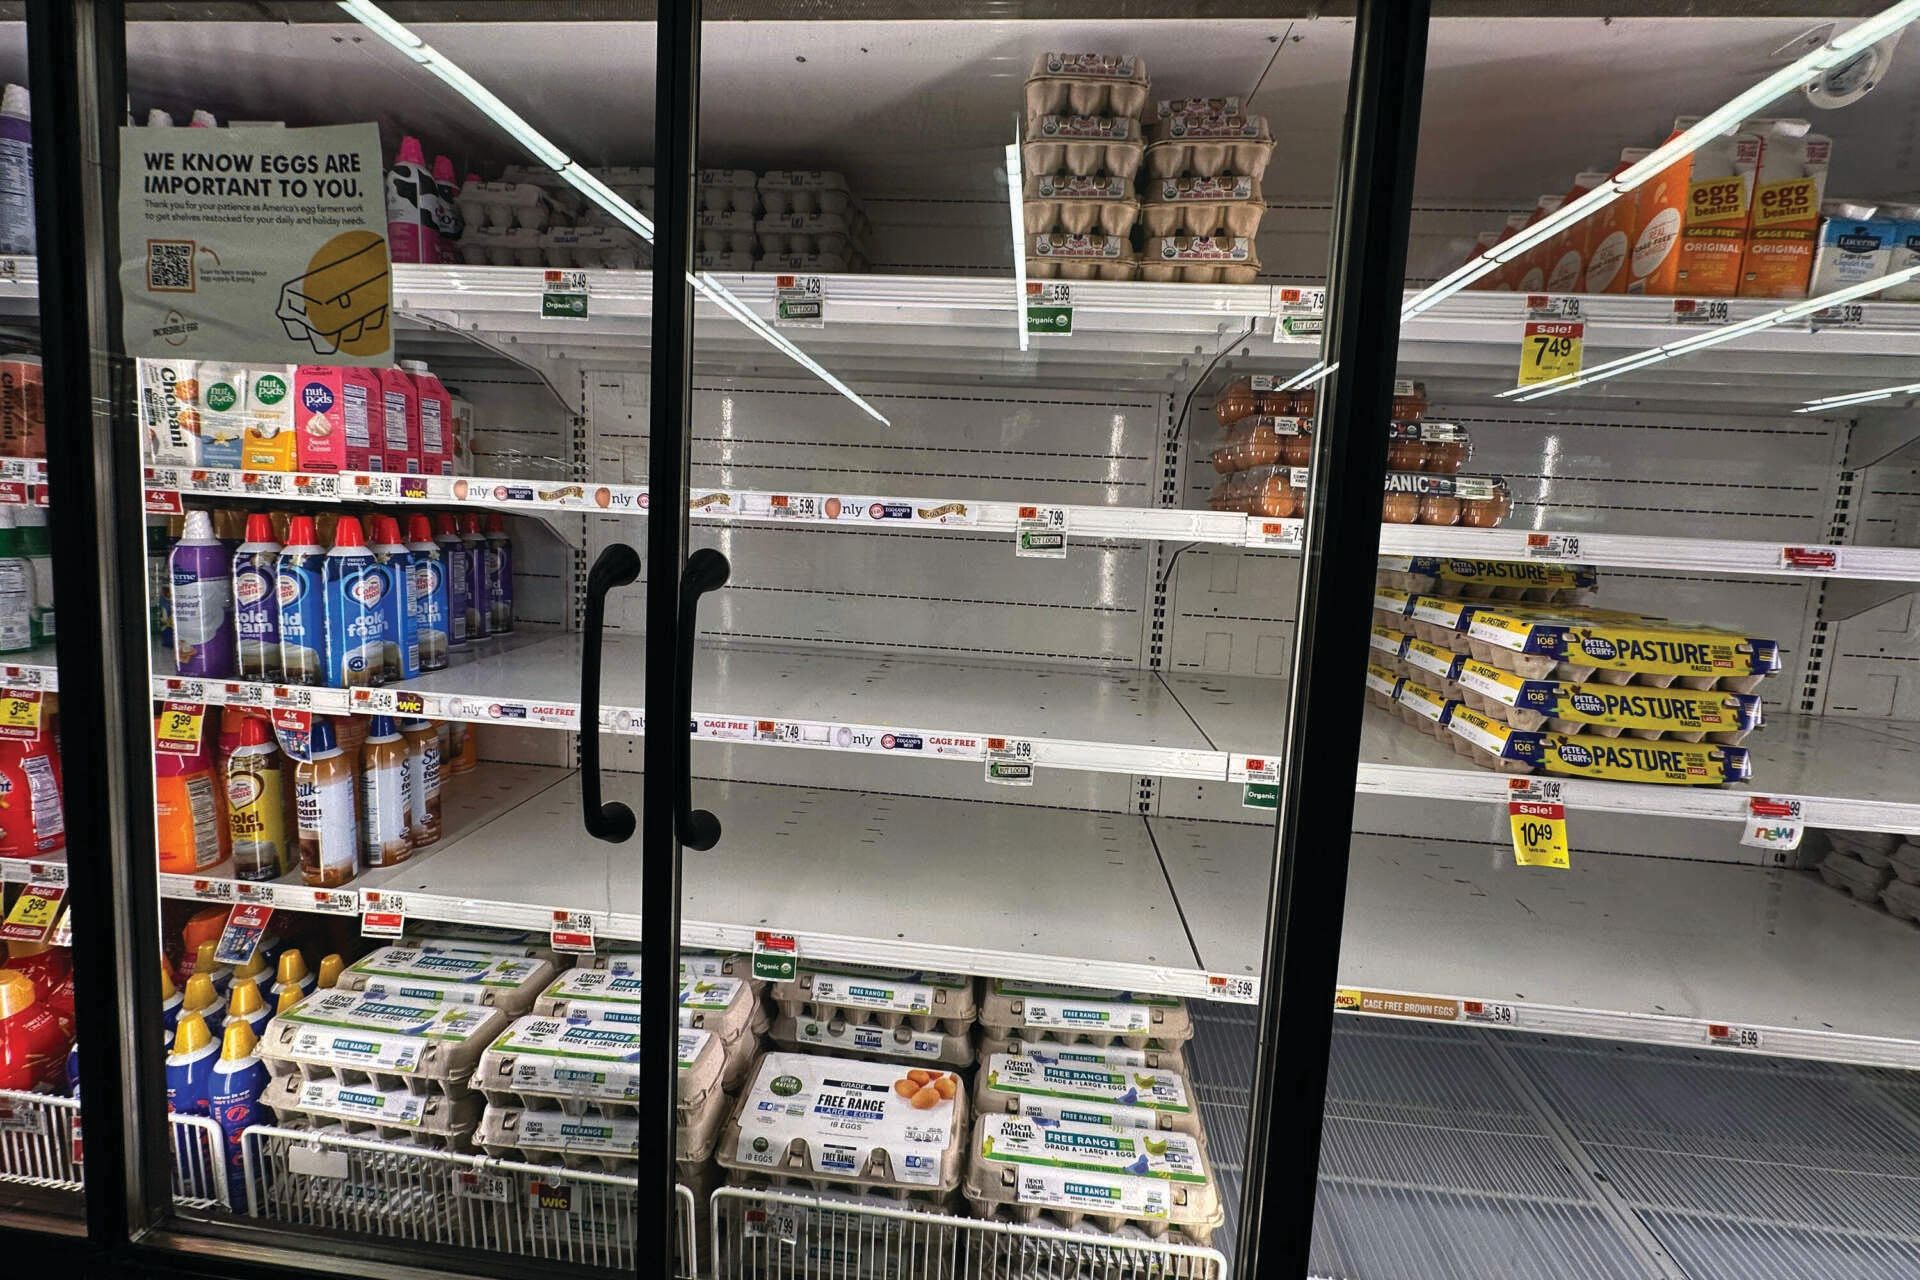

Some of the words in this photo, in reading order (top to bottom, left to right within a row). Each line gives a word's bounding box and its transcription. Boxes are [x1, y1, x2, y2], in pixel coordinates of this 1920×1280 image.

[144, 153, 175, 171] WE
[182, 154, 253, 174] KNOW
[260, 155, 318, 174] EGGS
[325, 153, 361, 173] ARE
[144, 176, 272, 197] IMPORTANT
[279, 178, 308, 198] TO
[314, 179, 364, 199] YOU.
[1693, 182, 1740, 206] egg
[1761, 183, 1810, 208] egg
[145, 200, 168, 210] Thank
[169, 202, 185, 212] you
[186, 200, 197, 211] for
[198, 203, 215, 213] your
[217, 201, 252, 213] patience
[252, 204, 261, 212] as
[262, 203, 300, 213] America's
[301, 205, 316, 216] egg
[317, 203, 345, 213] farmers
[346, 204, 364, 212] work
[1694, 204, 1739, 218] beaters
[1763, 204, 1808, 219] beaters
[145, 213, 154, 222] to
[155, 214, 170, 223] get
[172, 213, 200, 223] shelves
[202, 213, 242, 223] restocked
[243, 213, 255, 223] for
[256, 216, 275, 226] your
[276, 214, 295, 227] daily
[296, 214, 311, 225] and
[312, 215, 340, 227] holiday
[342, 216, 366, 226] needs.
[1839, 236, 1880, 247] Lucerne
[1684, 242, 1740, 254] ORIGINAL
[1752, 244, 1811, 256] ORIGINAL
[546, 302, 570, 310] Organic
[1026, 315, 1053, 325] Organic
[1536, 324, 1572, 334] Sale!
[259, 379, 277, 389] nut
[258, 386, 286, 398] pods
[305, 386, 324, 397] nut
[209, 392, 236, 405] pods
[304, 394, 333, 406] pods
[161, 367, 188, 449] Chobani
[1384, 475, 1430, 493] ANIC
[404, 490, 426, 499] WIC
[1478, 561, 1548, 580] PASTURE
[1536, 636, 1555, 646] 108
[1584, 639, 1603, 648] PETE
[1617, 638, 1713, 666] PASTURE
[1691, 664, 1713, 673] RAISED
[10, 690, 35, 699] Sale!
[1574, 695, 1593, 704] PETE
[171, 703, 196, 712] Sale!
[398, 699, 421, 711] WIC
[1605, 693, 1700, 721] PASTURE
[532, 707, 552, 716] CAGE
[553, 708, 576, 717] FREE
[703, 720, 726, 730] CAGE
[728, 721, 749, 730] FREE
[1680, 720, 1702, 728] RAISED
[929, 737, 952, 747] CAGE
[954, 738, 976, 748] FREE
[1561, 745, 1581, 754] PETE
[1592, 744, 1686, 773] PASTURE
[1665, 771, 1687, 780] RAISED
[1248, 791, 1276, 800] Organic
[1519, 803, 1553, 815] Sale!
[31, 888, 55, 896] Sale!
[443, 960, 475, 969] RANGE
[756, 962, 780, 973] Organic
[614, 980, 636, 989] FREE
[850, 988, 865, 996] FREE
[866, 989, 886, 999] RANGE
[360, 1003, 383, 1012] FREE
[386, 1006, 420, 1018] RANGE
[1363, 998, 1383, 1010] CAGE
[1384, 1000, 1402, 1011] FREE
[1404, 1001, 1433, 1014] BROWN
[1434, 1005, 1455, 1017] EGGS
[569, 1029, 595, 1040] FREE
[596, 1031, 632, 1042] RANGE
[779, 1075, 797, 1084] OPEN
[1047, 1069, 1072, 1079] FREE
[1074, 1071, 1109, 1083] RANGE
[775, 1081, 800, 1091] NATURE
[839, 1081, 863, 1089] GRADE
[1043, 1077, 1068, 1085] GRADE
[1079, 1081, 1102, 1089] LARGE
[1107, 1084, 1128, 1092] EGGS
[817, 1094, 845, 1108] FREE
[847, 1098, 886, 1113] RANGE
[820, 1106, 850, 1117] LARGE
[852, 1109, 878, 1120] EGGS
[563, 1125, 579, 1135] FREE
[580, 1127, 602, 1137] RANGE
[830, 1121, 841, 1129] 18
[842, 1121, 863, 1131] EGGS
[1048, 1132, 1075, 1145] FREE
[1077, 1135, 1117, 1150] RANGE
[1044, 1143, 1071, 1152] GRADE
[1083, 1148, 1110, 1157] LARGE
[1115, 1151, 1138, 1160] EGGS
[745, 1153, 753, 1161] 18
[753, 1154, 773, 1163] EGGS
[822, 1152, 836, 1162] FREE
[837, 1154, 856, 1165] RANGE
[1066, 1183, 1084, 1195] FREE
[1085, 1186, 1111, 1198] RANGE
[541, 1196, 568, 1210] WIC
